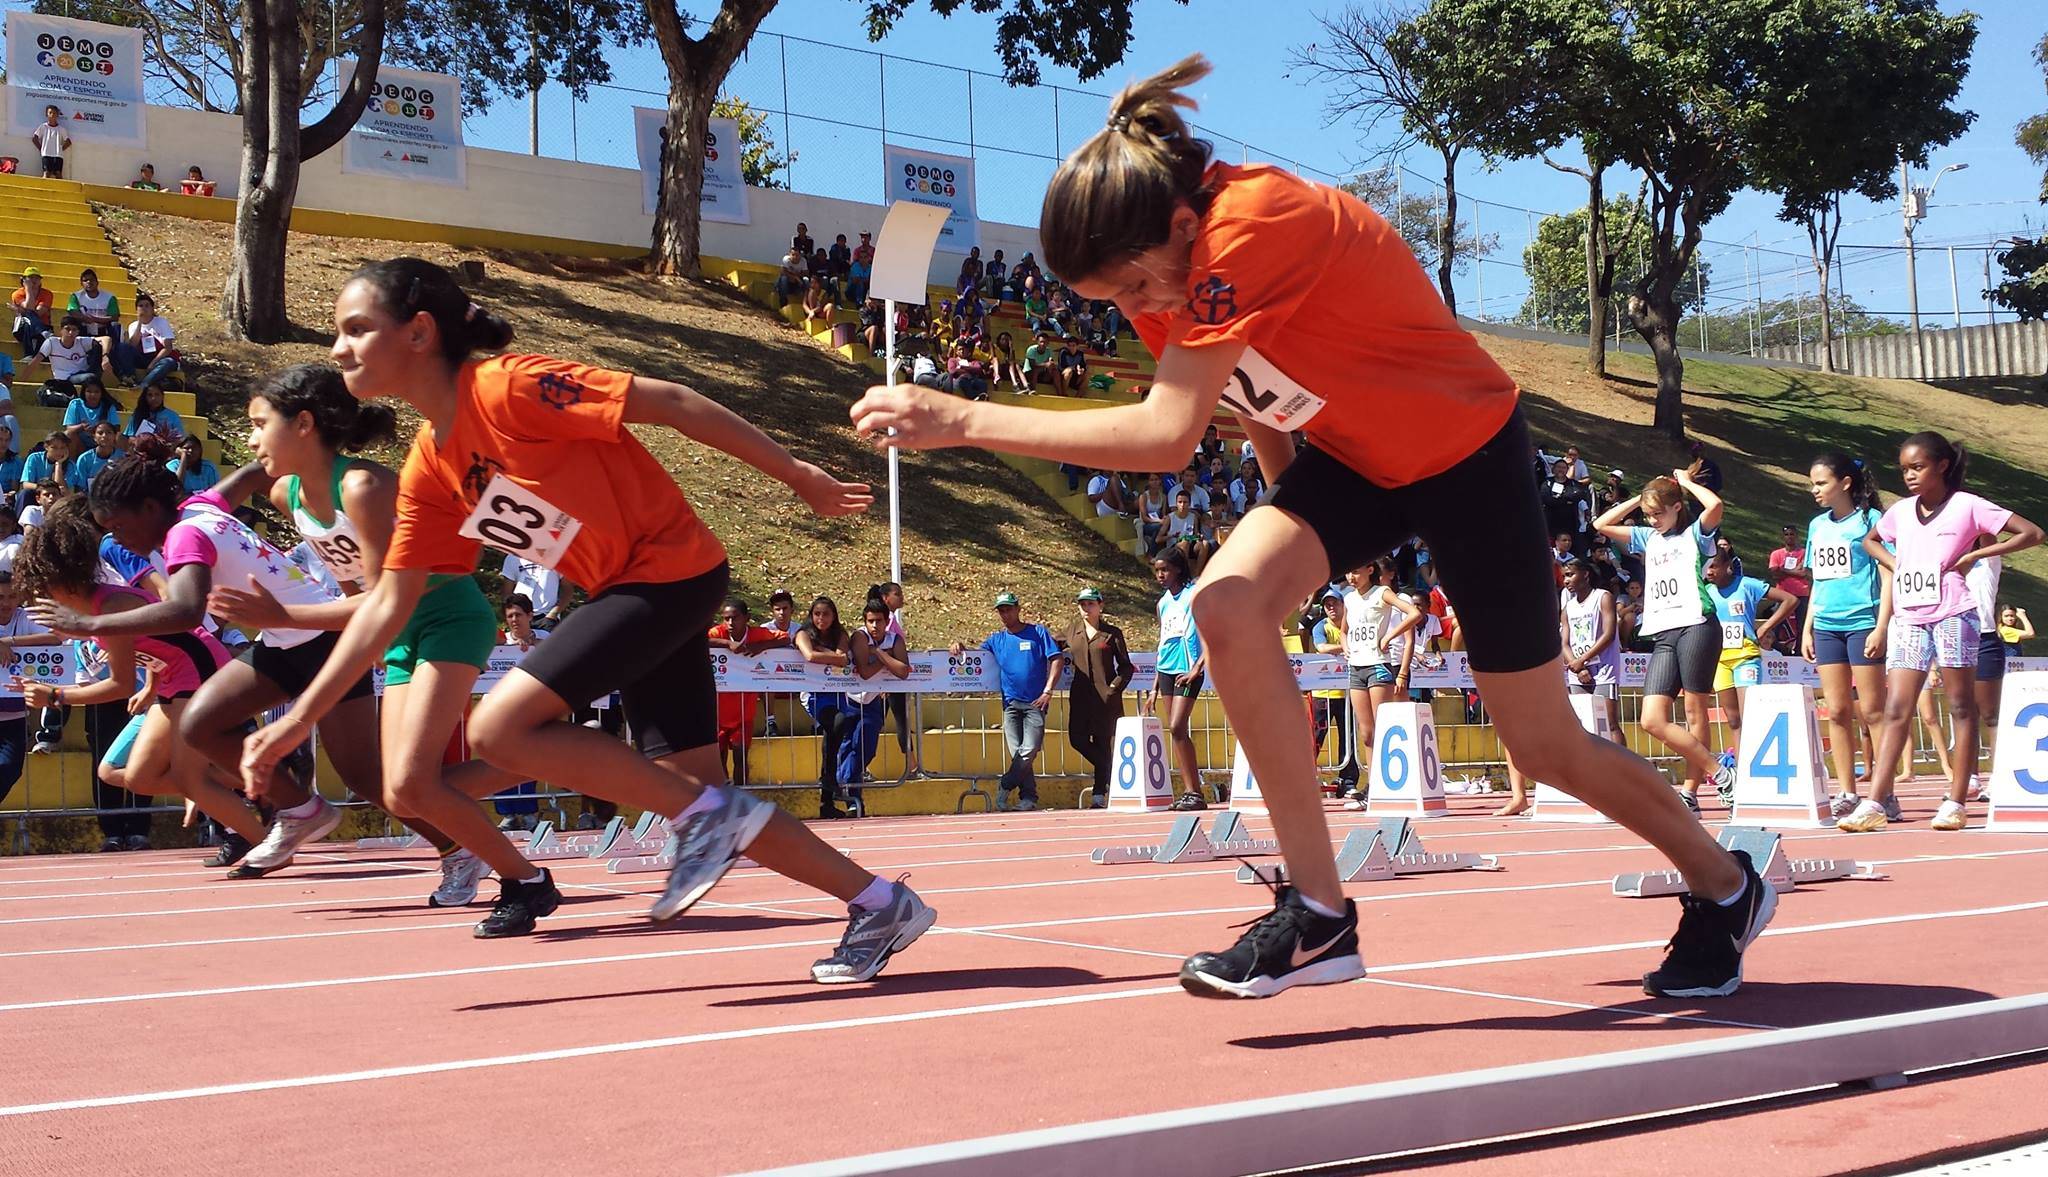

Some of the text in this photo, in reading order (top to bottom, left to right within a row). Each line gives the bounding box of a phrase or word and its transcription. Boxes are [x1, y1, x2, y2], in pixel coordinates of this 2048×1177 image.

[42, 37, 110, 57] JEMG
[80, 60, 91, 70] 13
[40, 82, 61, 91] COM
[73, 86, 112, 97] ESPORTE
[44, 74, 106, 88] APRENDENDO
[371, 85, 431, 100] JEMG
[374, 120, 428, 132] APRENDENDO
[908, 165, 953, 179] JEMG
[911, 198, 952, 208] APRENDENDO
[1280, 392, 1305, 413] GOVERNO
[477, 494, 546, 550] 03
[1813, 547, 1847, 567] 1588
[1896, 571, 1937, 595] 1904
[1350, 626, 1376, 642] 1685
[1381, 725, 1409, 791] 6
[1420, 723, 1438, 790] 6
[1750, 712, 1797, 794] 4
[2013, 702, 2048, 795] 3
[1118, 735, 1136, 790] 8
[1146, 734, 1165, 790] 8
